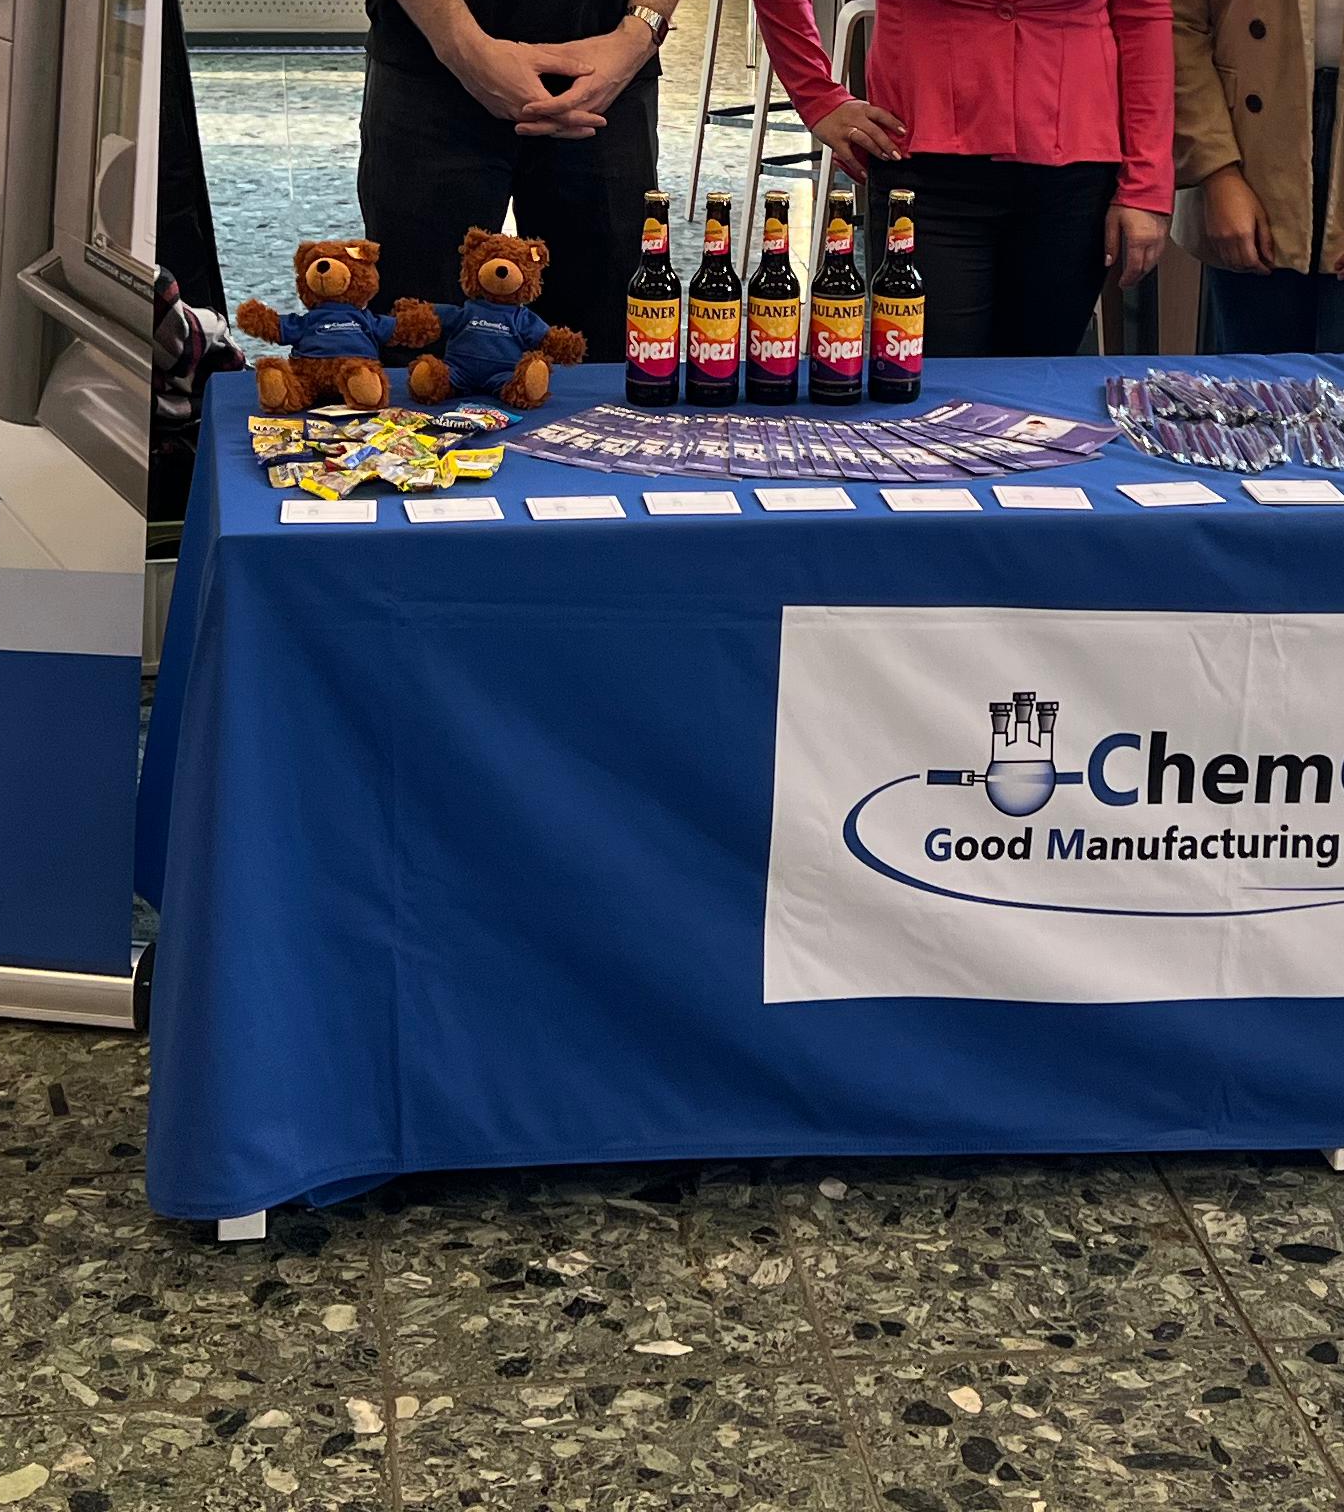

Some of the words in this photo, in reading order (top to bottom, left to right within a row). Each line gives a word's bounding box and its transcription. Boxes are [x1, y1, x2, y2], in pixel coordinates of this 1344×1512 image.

[642, 239, 663, 252] pezi
[628, 303, 675, 319] ULANER
[628, 330, 675, 363] Spezi
[689, 331, 736, 364] Spezi
[750, 330, 796, 362] Spezi
[925, 827, 1033, 862] Good
[1046, 824, 1341, 867] Manufacturing
